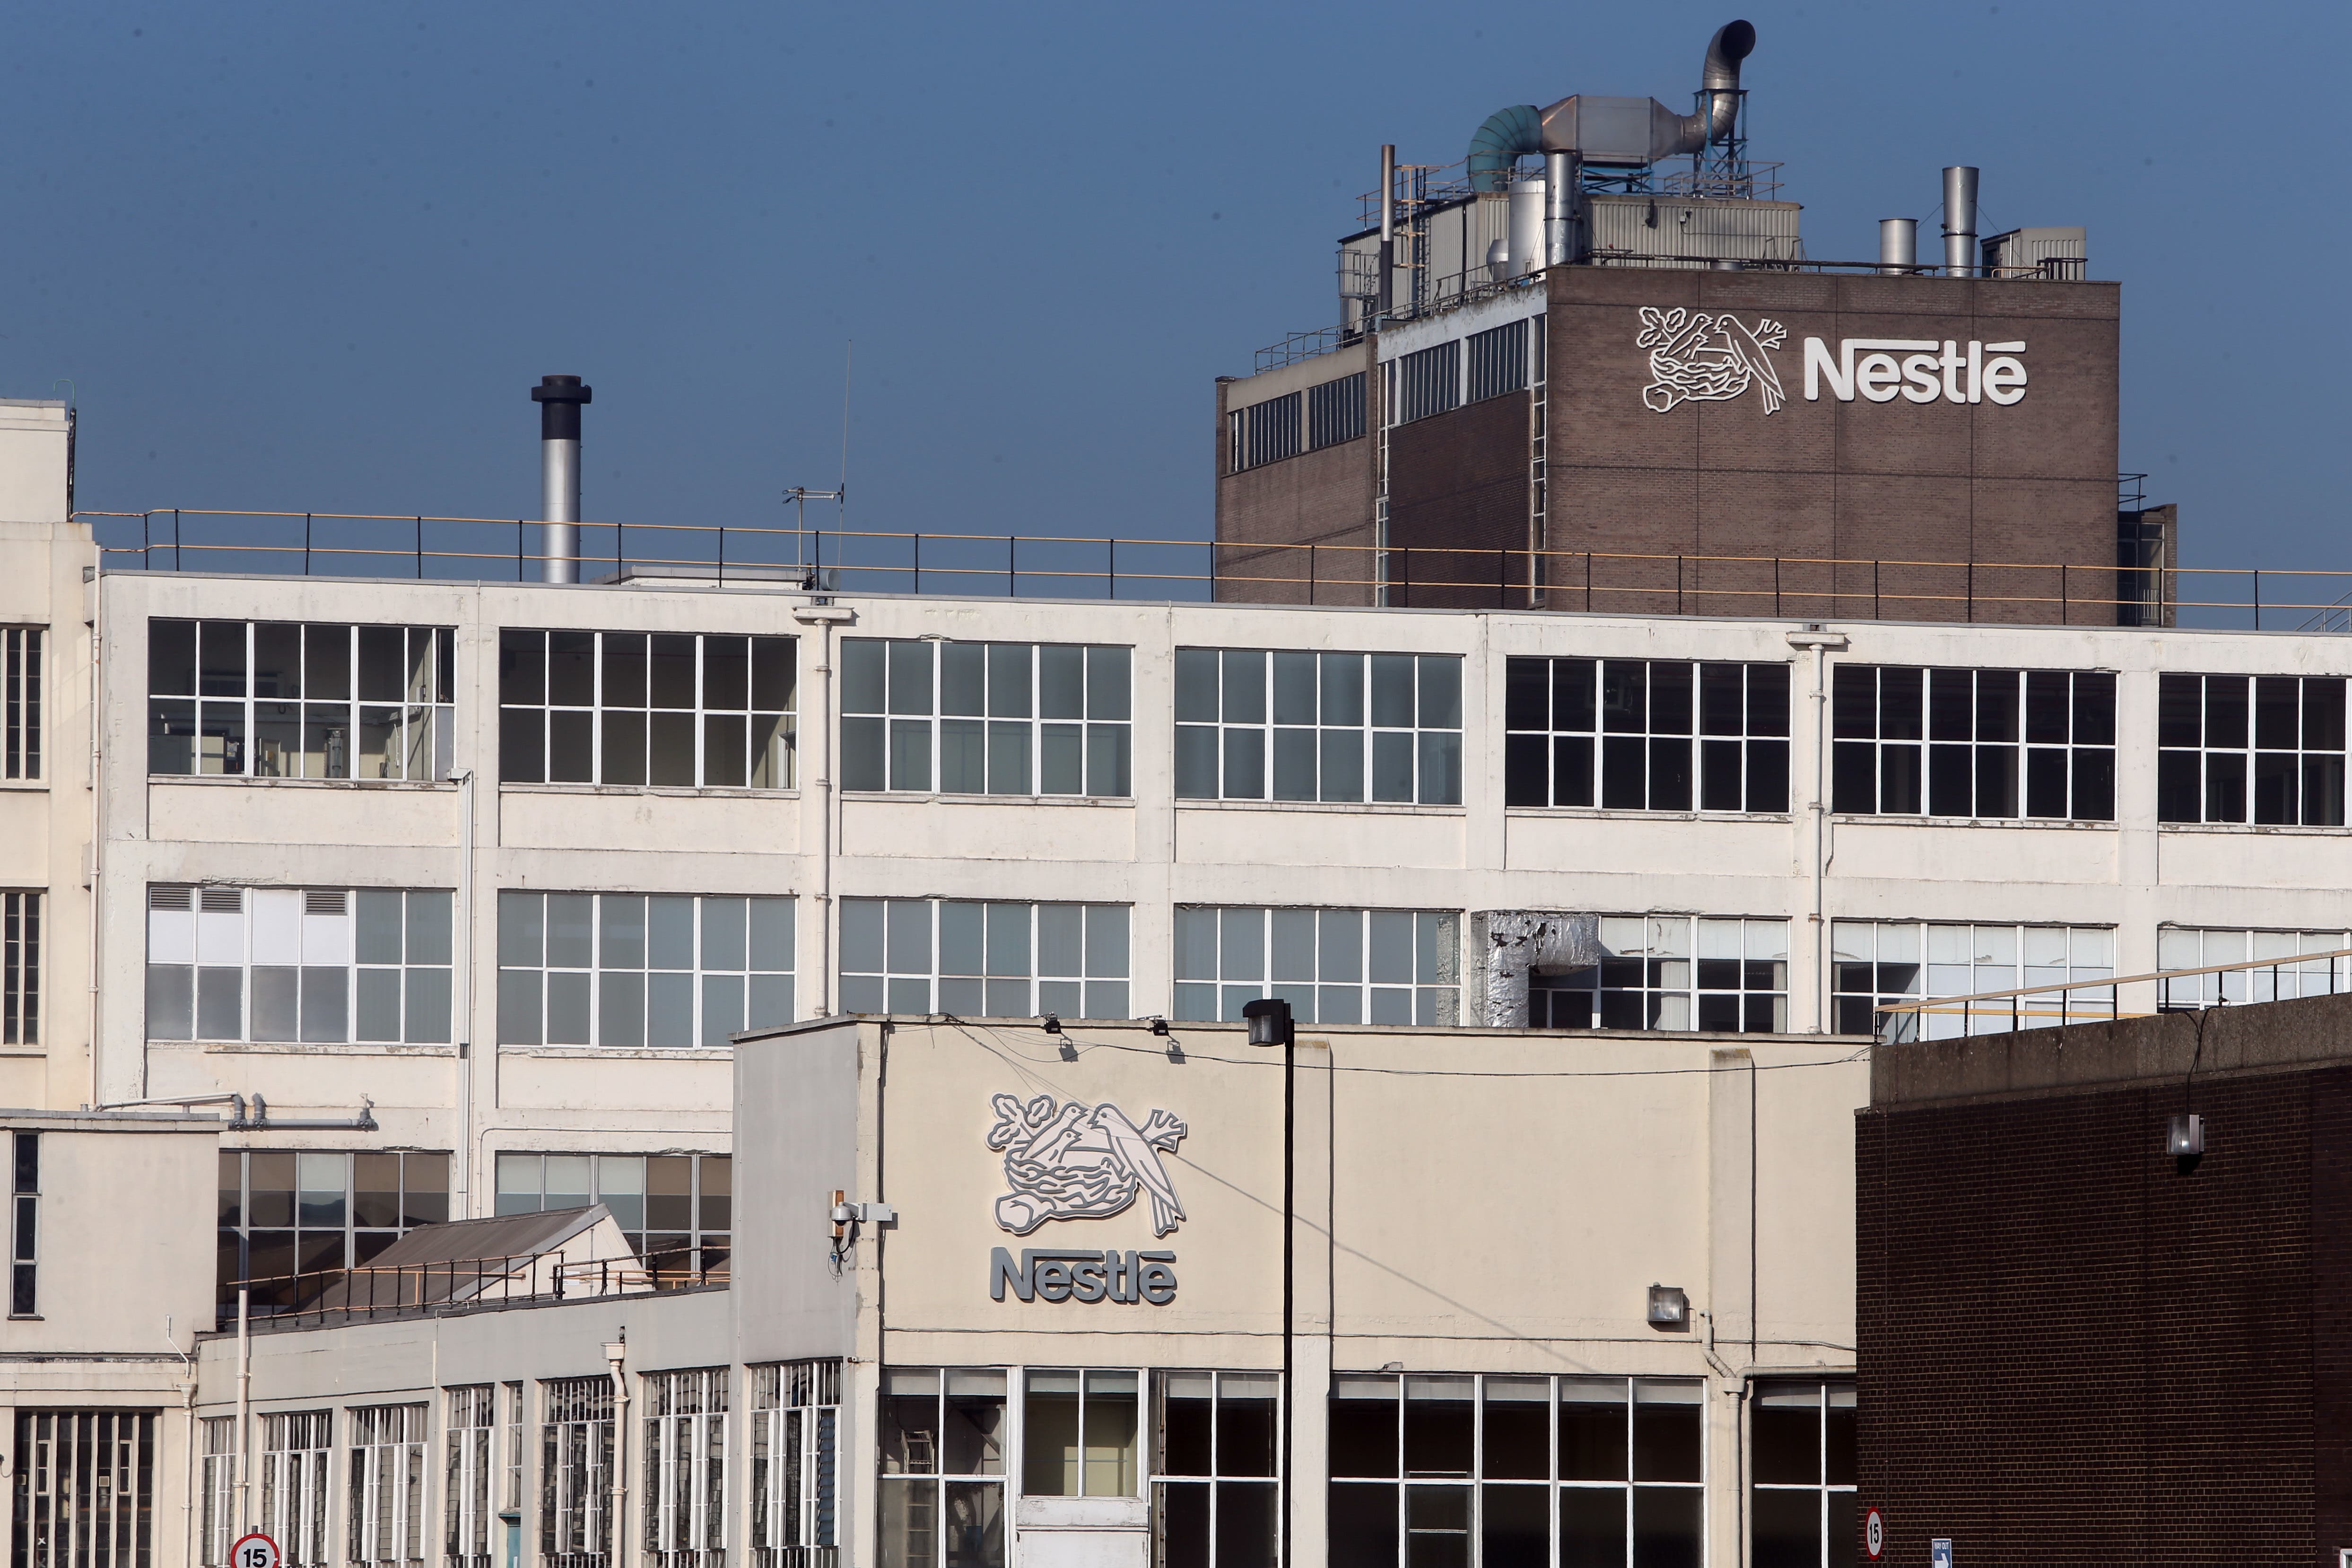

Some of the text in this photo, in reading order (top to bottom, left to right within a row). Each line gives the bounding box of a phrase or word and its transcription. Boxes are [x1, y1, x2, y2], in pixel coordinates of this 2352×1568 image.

[1803, 337, 2028, 405] Nestlé
[990, 1247, 1176, 1303] Nestlé
[1869, 1523, 1879, 1544] 15
[243, 1549, 267, 1568] 15
